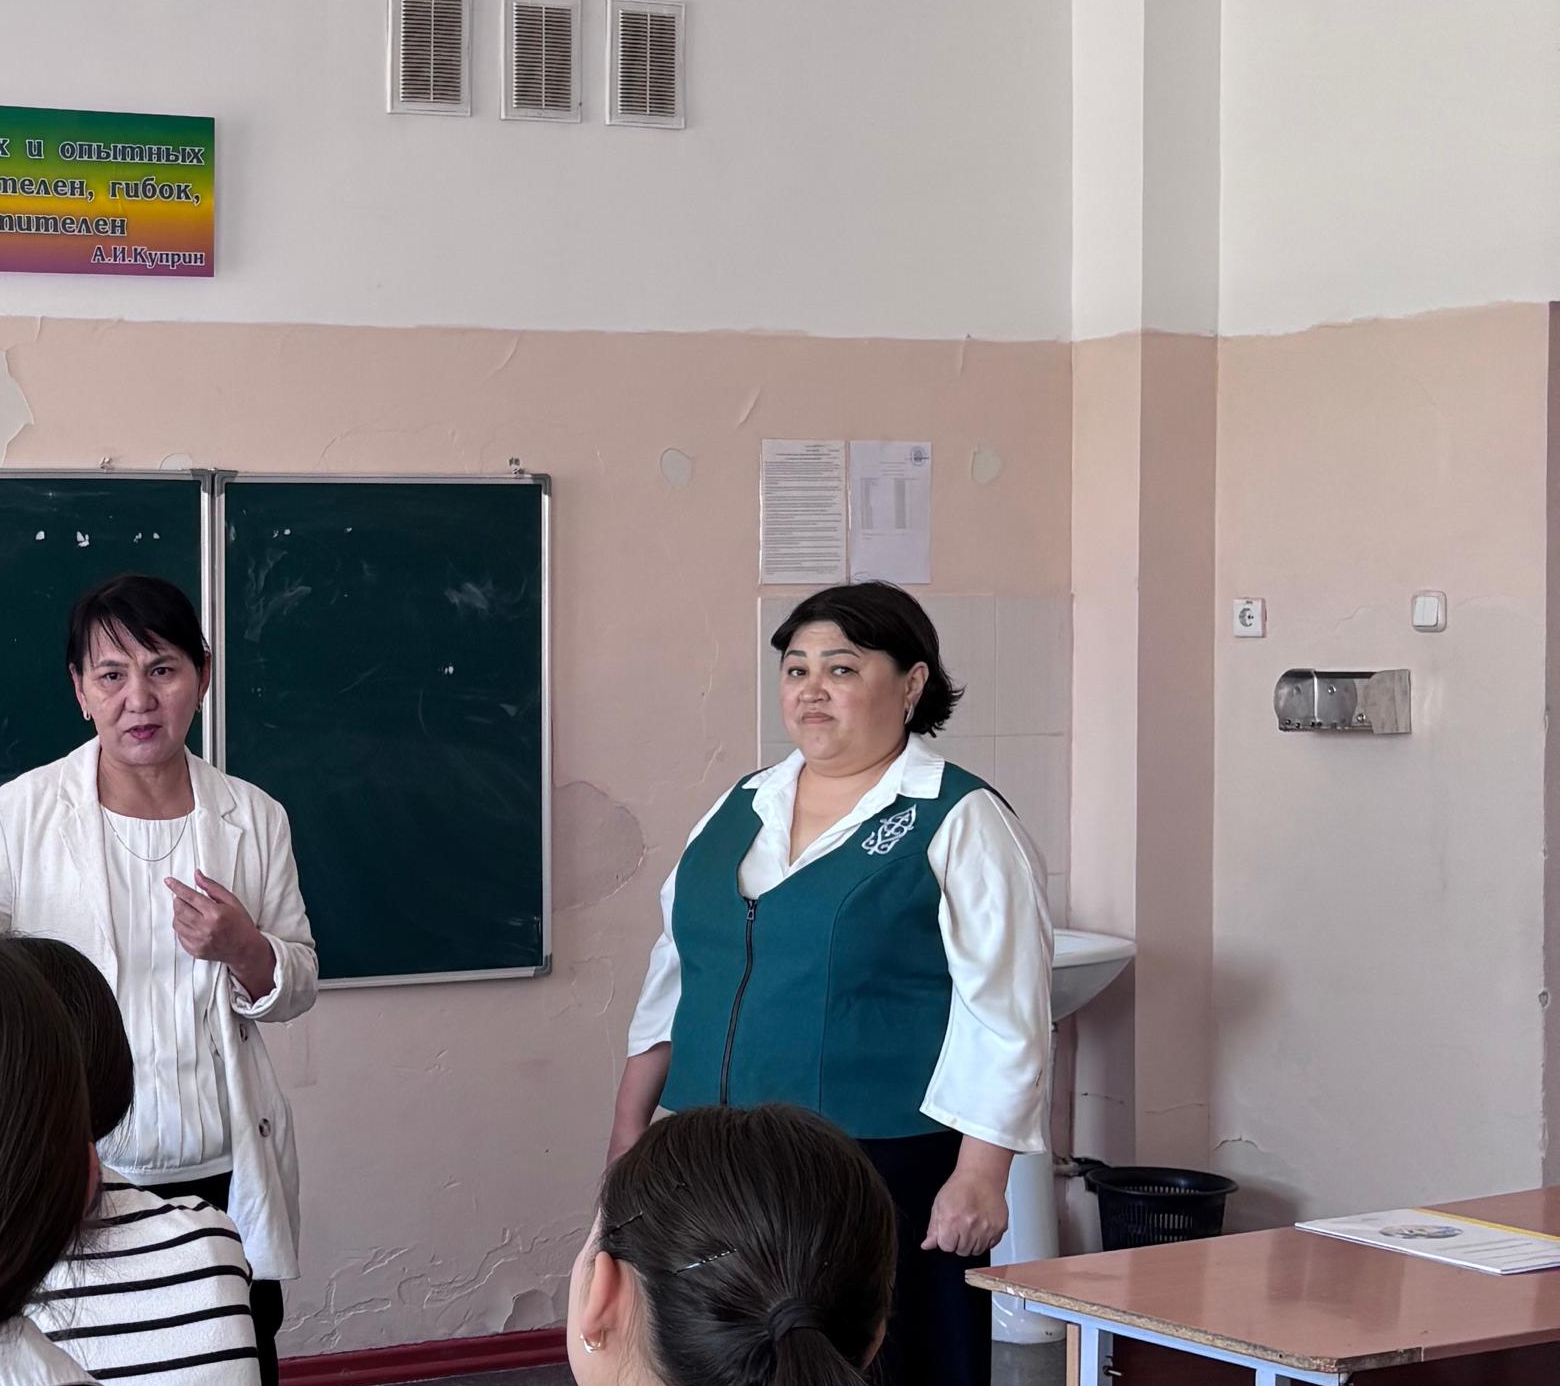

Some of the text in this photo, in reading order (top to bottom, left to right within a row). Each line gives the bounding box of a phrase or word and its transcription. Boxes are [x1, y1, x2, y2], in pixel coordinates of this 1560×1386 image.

[26, 139, 44, 160] и
[58, 143, 205, 165] опытных
[109, 176, 202, 206] гибок,
[91, 245, 205, 269] А.И.Куприн
